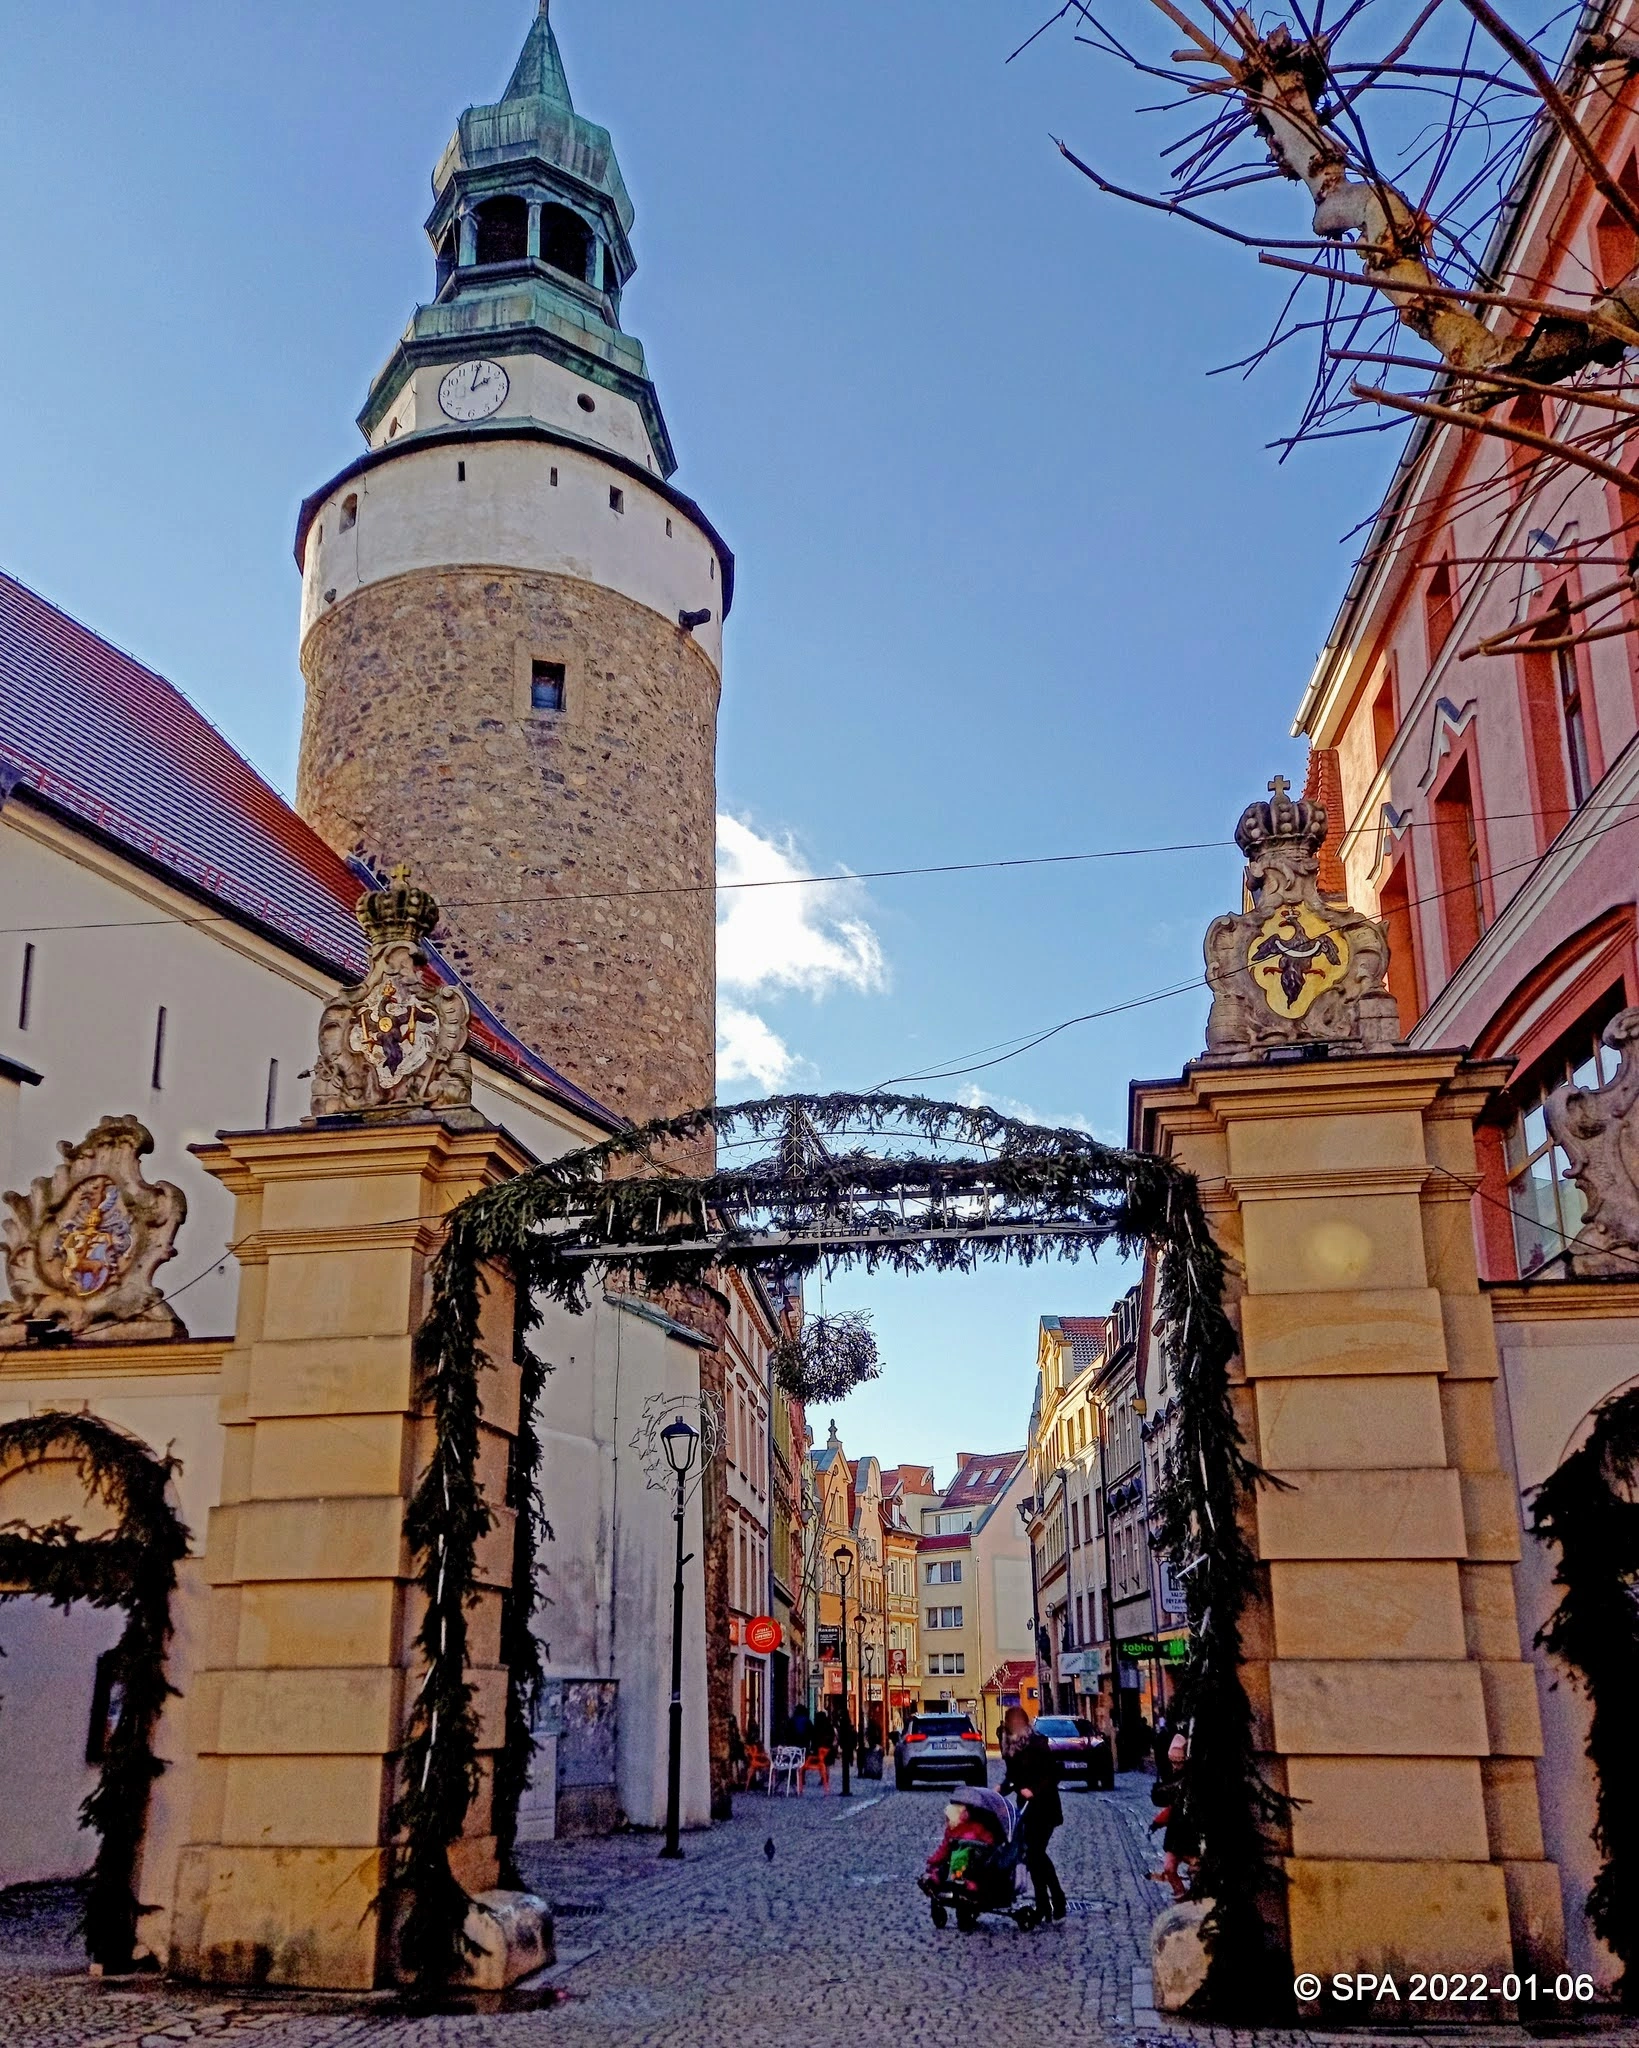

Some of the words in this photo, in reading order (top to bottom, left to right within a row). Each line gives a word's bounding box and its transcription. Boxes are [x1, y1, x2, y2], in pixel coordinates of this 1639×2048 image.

[458, 369, 466, 377] 11
[493, 371, 501, 379] 2
[448, 378, 459, 387] 10
[497, 382, 505, 391] 3
[442, 389, 450, 398] 9
[446, 400, 453, 408] 8
[483, 403, 490, 412] 5
[455, 407, 462, 415] 7
[467, 409, 475, 418] 6
